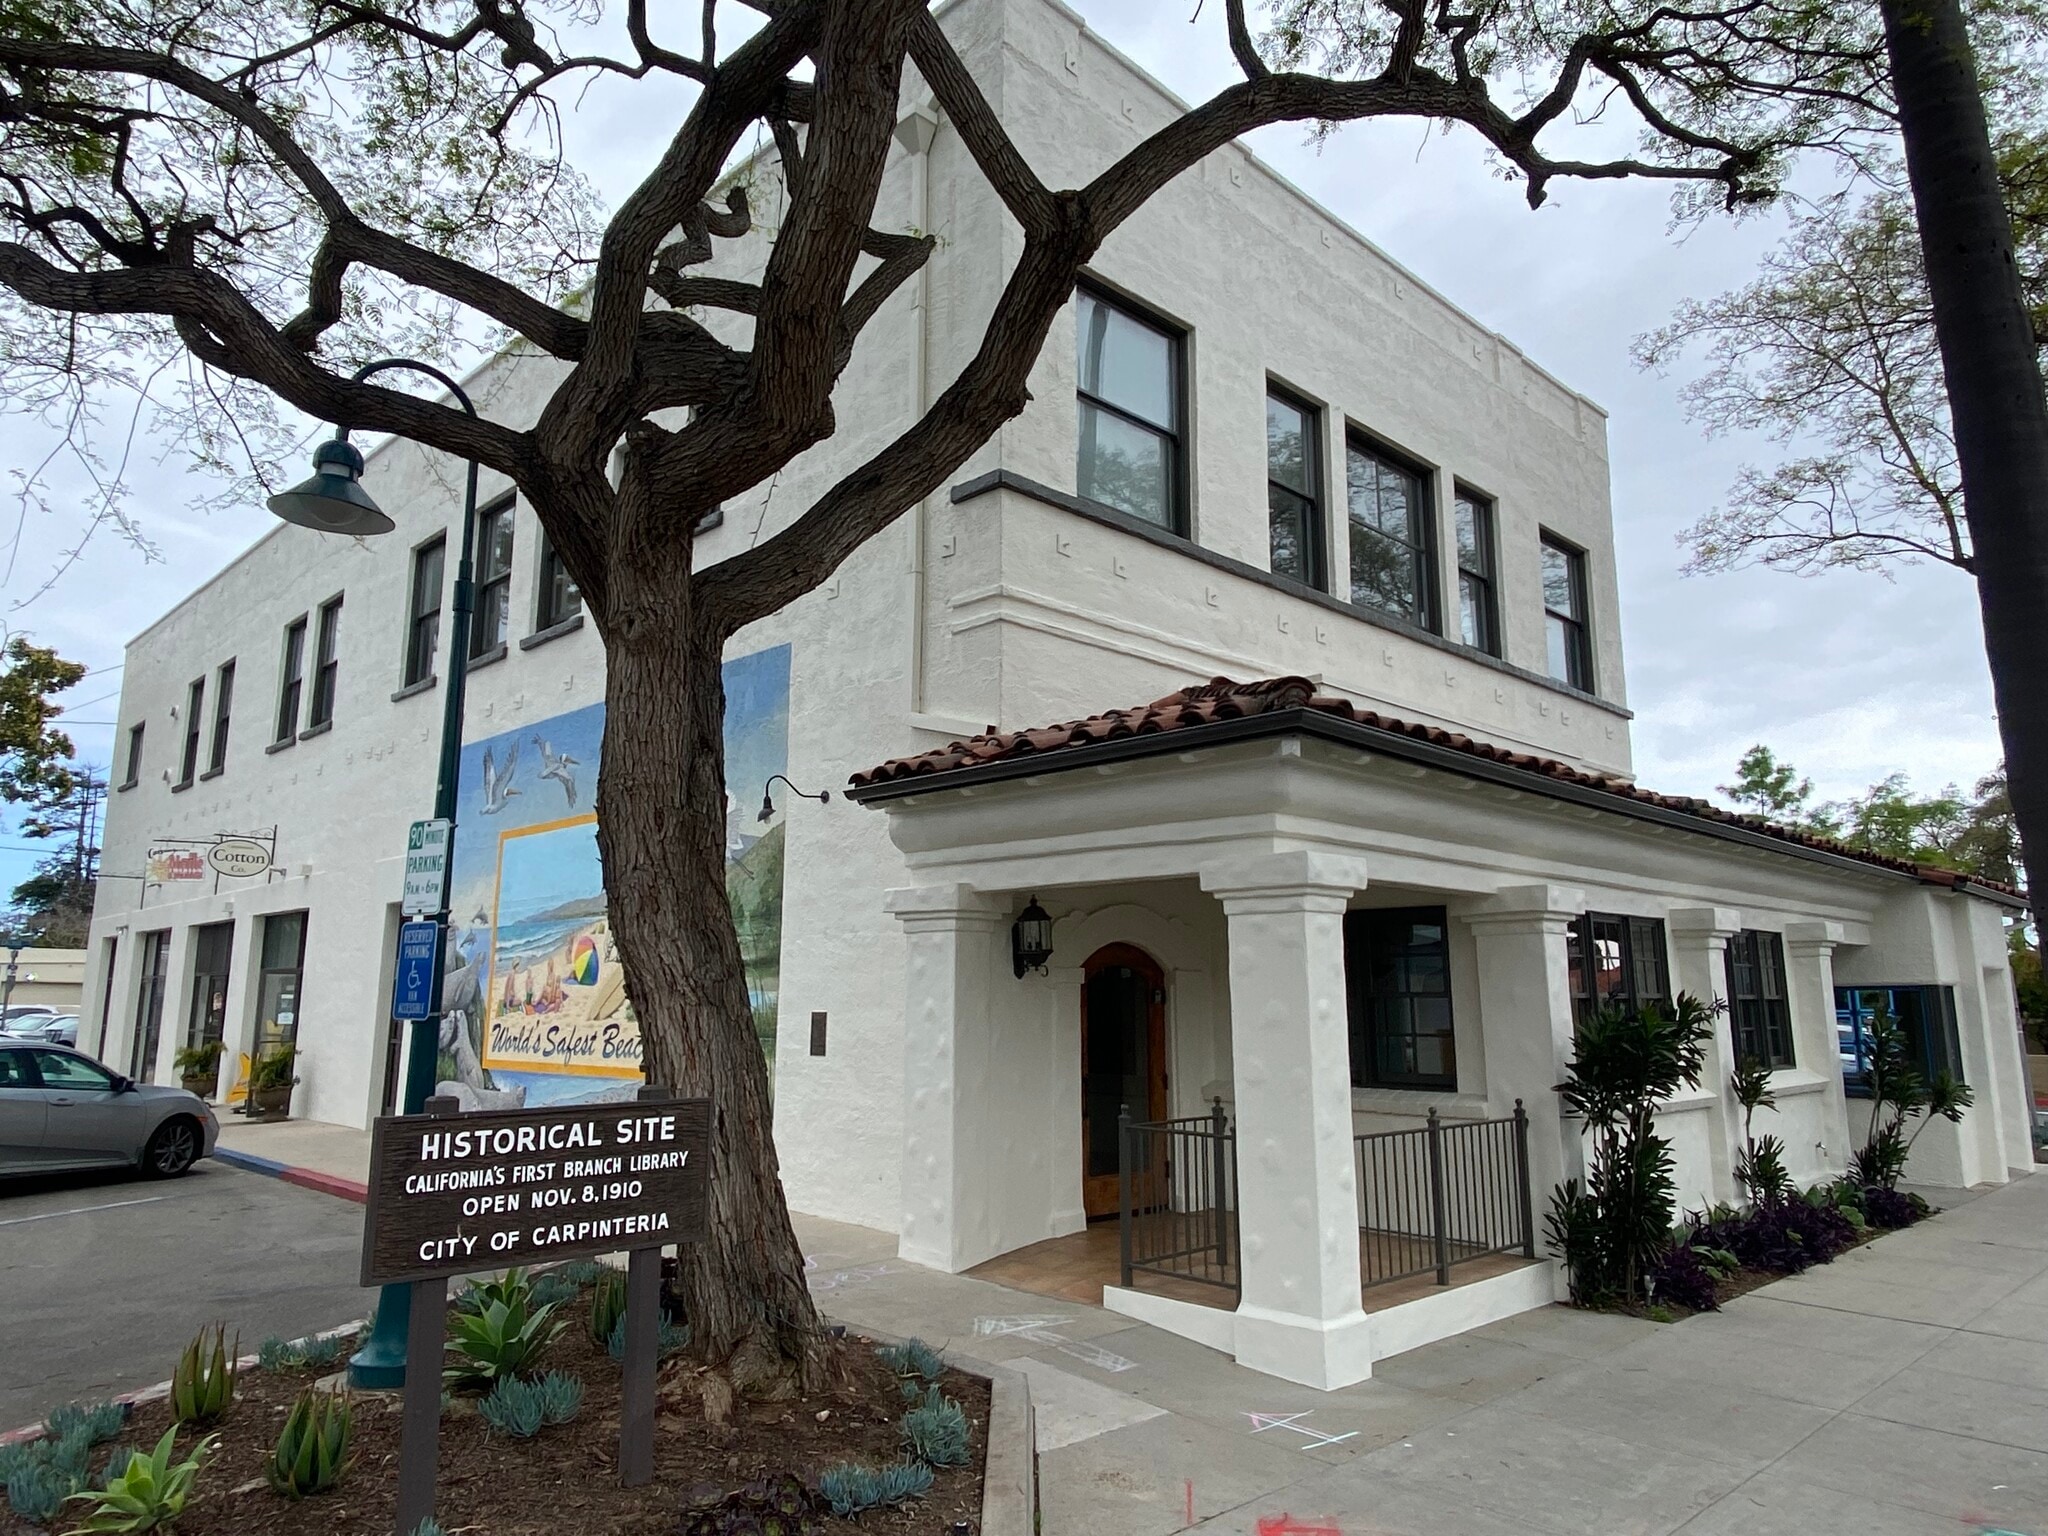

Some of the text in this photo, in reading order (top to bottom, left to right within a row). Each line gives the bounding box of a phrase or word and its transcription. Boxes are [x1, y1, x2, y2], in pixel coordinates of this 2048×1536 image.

[411, 826, 423, 847] 90
[213, 848, 265, 864] Cotton
[230, 864, 247, 873] Co.
[408, 855, 443, 873] PARKING
[404, 929, 433, 944] RESERVED
[491, 1020, 643, 1066] World's Safest Beac
[421, 1116, 676, 1160] HISTORICAL SITE
[405, 1150, 689, 1194] CALIFORNIA'S FIRST BRANCH LIBRARY
[463, 1194, 520, 1216] OPEN
[531, 1186, 577, 1209] NOV.
[419, 1212, 670, 1261] CITY OF CARPINTERIA
